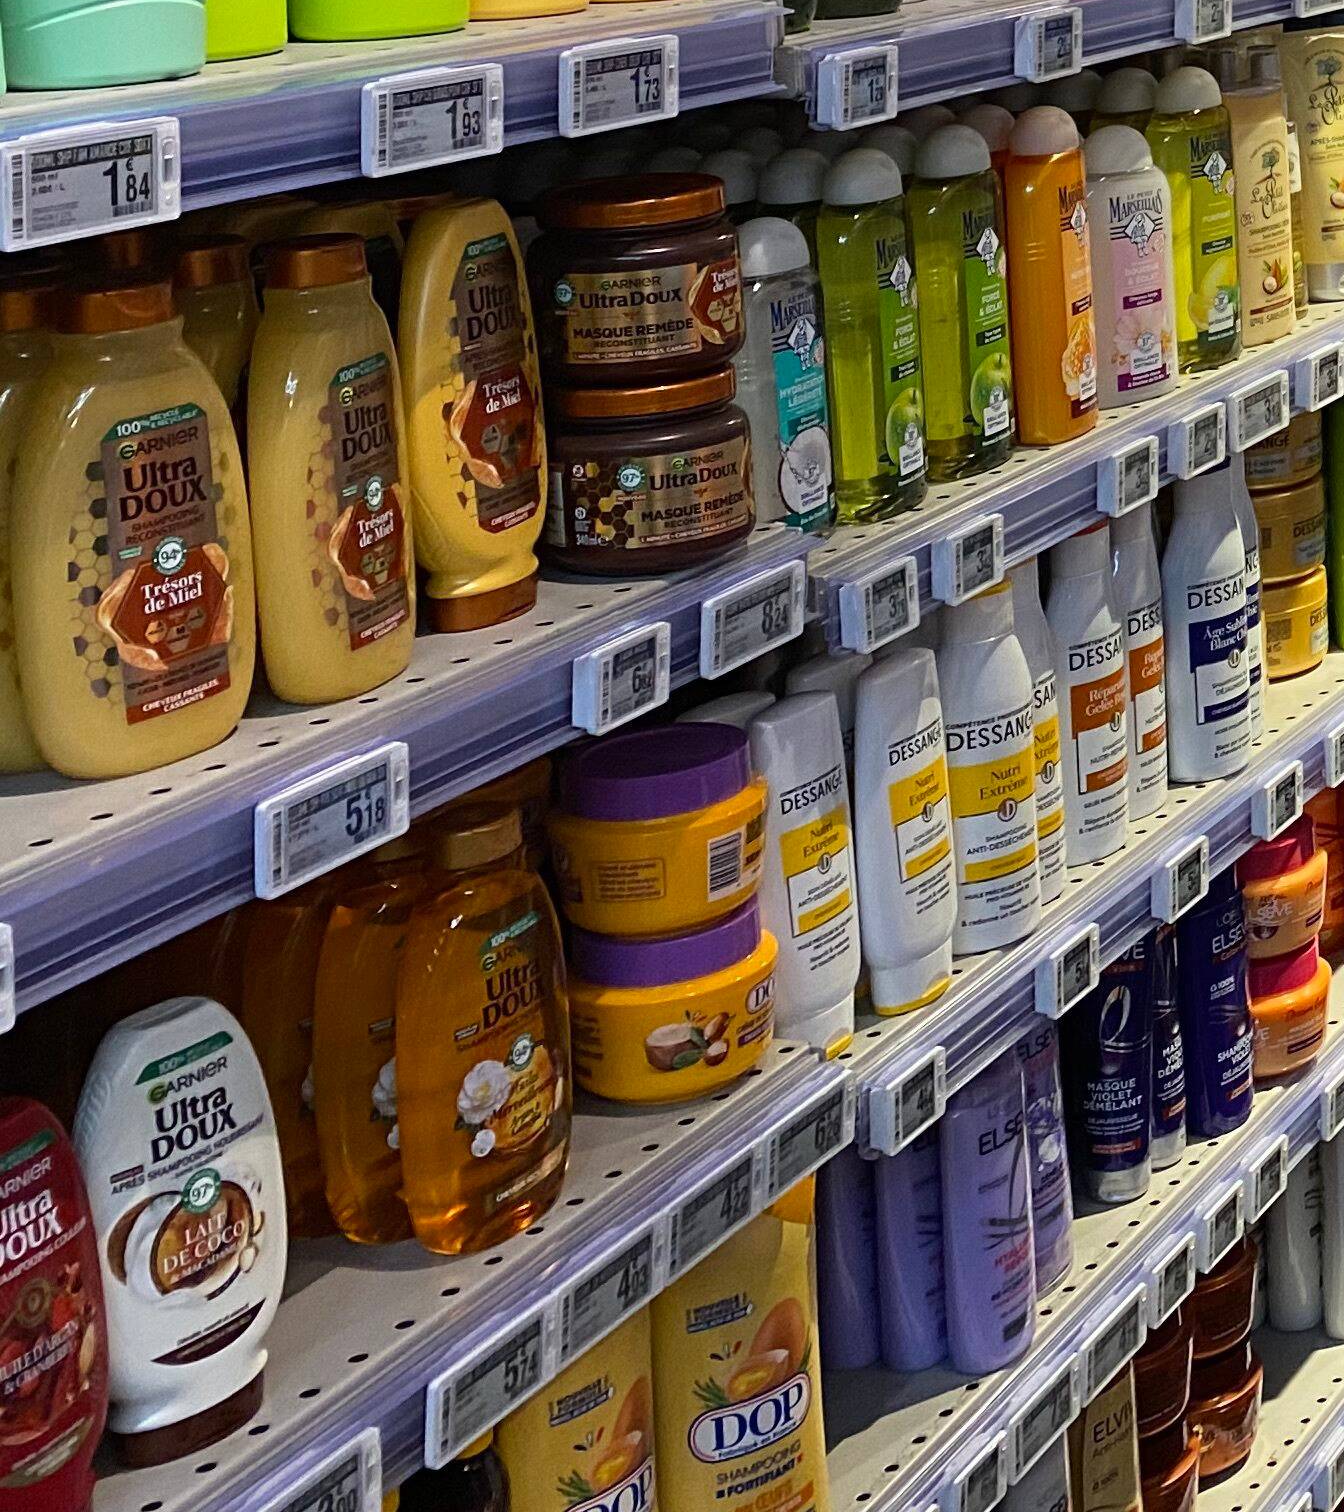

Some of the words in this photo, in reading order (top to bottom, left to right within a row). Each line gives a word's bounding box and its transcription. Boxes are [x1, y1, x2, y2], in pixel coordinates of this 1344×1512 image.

[468, 284, 512, 314] Ultra
[601, 276, 661, 290] GARNIER
[573, 324, 633, 338] MASQUE
[636, 317, 694, 335] REMÈDE
[482, 376, 521, 400] Trésors
[485, 394, 501, 414] de
[502, 387, 521, 409] Miel
[342, 402, 388, 435] Ultra
[118, 424, 199, 460] GARNIER
[341, 422, 392, 460] DOUX
[122, 458, 198, 495] Ultra
[118, 477, 207, 521] DOUX
[641, 500, 691, 524] MASQUE
[694, 489, 744, 516] REMÈDE
[357, 507, 394, 536] Trésors
[359, 527, 374, 548] de
[375, 518, 395, 544] Miel
[140, 568, 202, 602] Trésors
[144, 593, 165, 612] de
[168, 581, 202, 609] Miel
[914, 772, 936, 794] Nutri
[978, 775, 1034, 803] Extrême
[989, 763, 1021, 784] Nutri
[808, 814, 833, 835] Nutri
[1087, 1078, 1136, 1093] MASQUE
[1090, 1089, 1132, 1103] VIOLET
[154, 1083, 228, 1136] Ultra
[149, 1103, 238, 1165] DOUX
[163, 1248, 193, 1276] DE
[193, 1218, 247, 1263] COCO
[183, 1217, 228, 1251] LAIT
[710, 1382, 806, 1454] DOP
[716, 1439, 800, 1489] SHAMPOOING
[726, 1451, 798, 1499] FORTIFIANT
